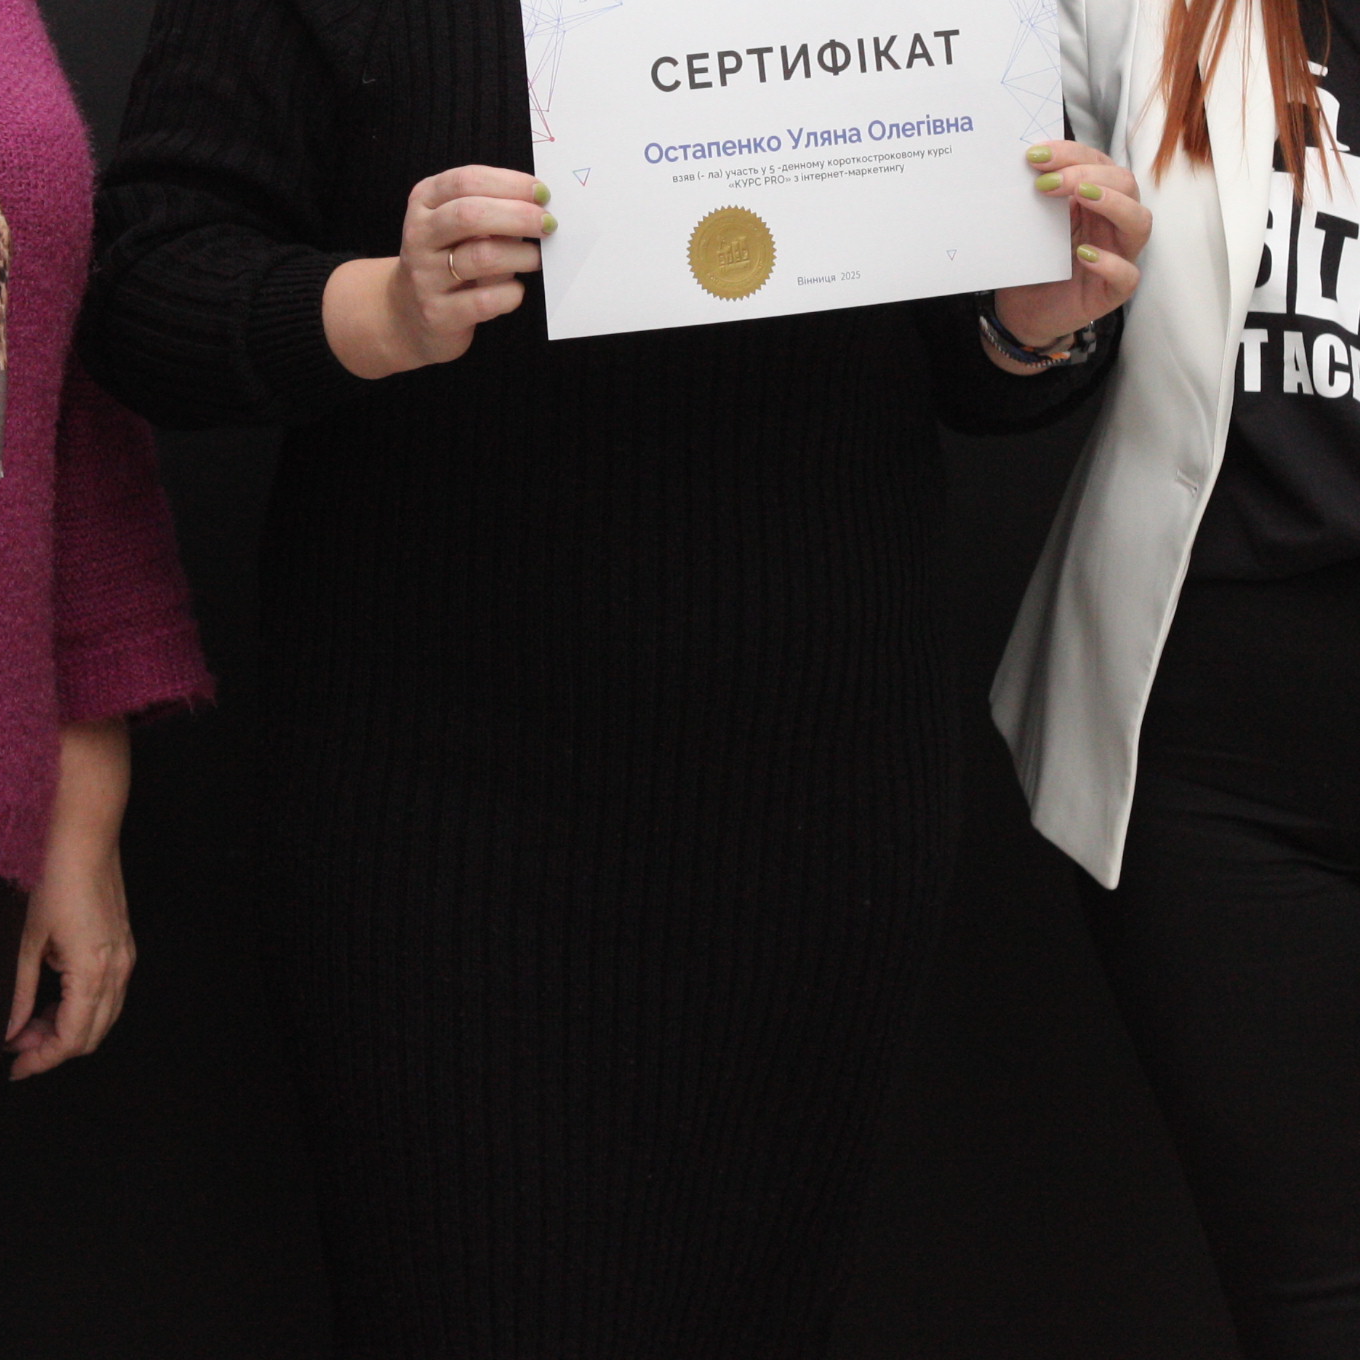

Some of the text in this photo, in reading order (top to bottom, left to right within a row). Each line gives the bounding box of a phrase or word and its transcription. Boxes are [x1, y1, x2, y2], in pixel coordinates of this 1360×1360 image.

[651, 29, 960, 92] СЕРТИФІКАТ
[644, 114, 973, 164] Остапенко Уляна Олегівна
[672, 173, 695, 183] взяв
[725, 166, 759, 179] участь
[827, 149, 925, 168] короткостроковому
[927, 145, 952, 158] курсі
[728, 177, 762, 189] «КУРС
[764, 174, 791, 186] PRO»
[801, 163, 905, 182] інтернет-маркетингу
[797, 274, 836, 286] Вінниця
[1240, 329, 1268, 393] T
